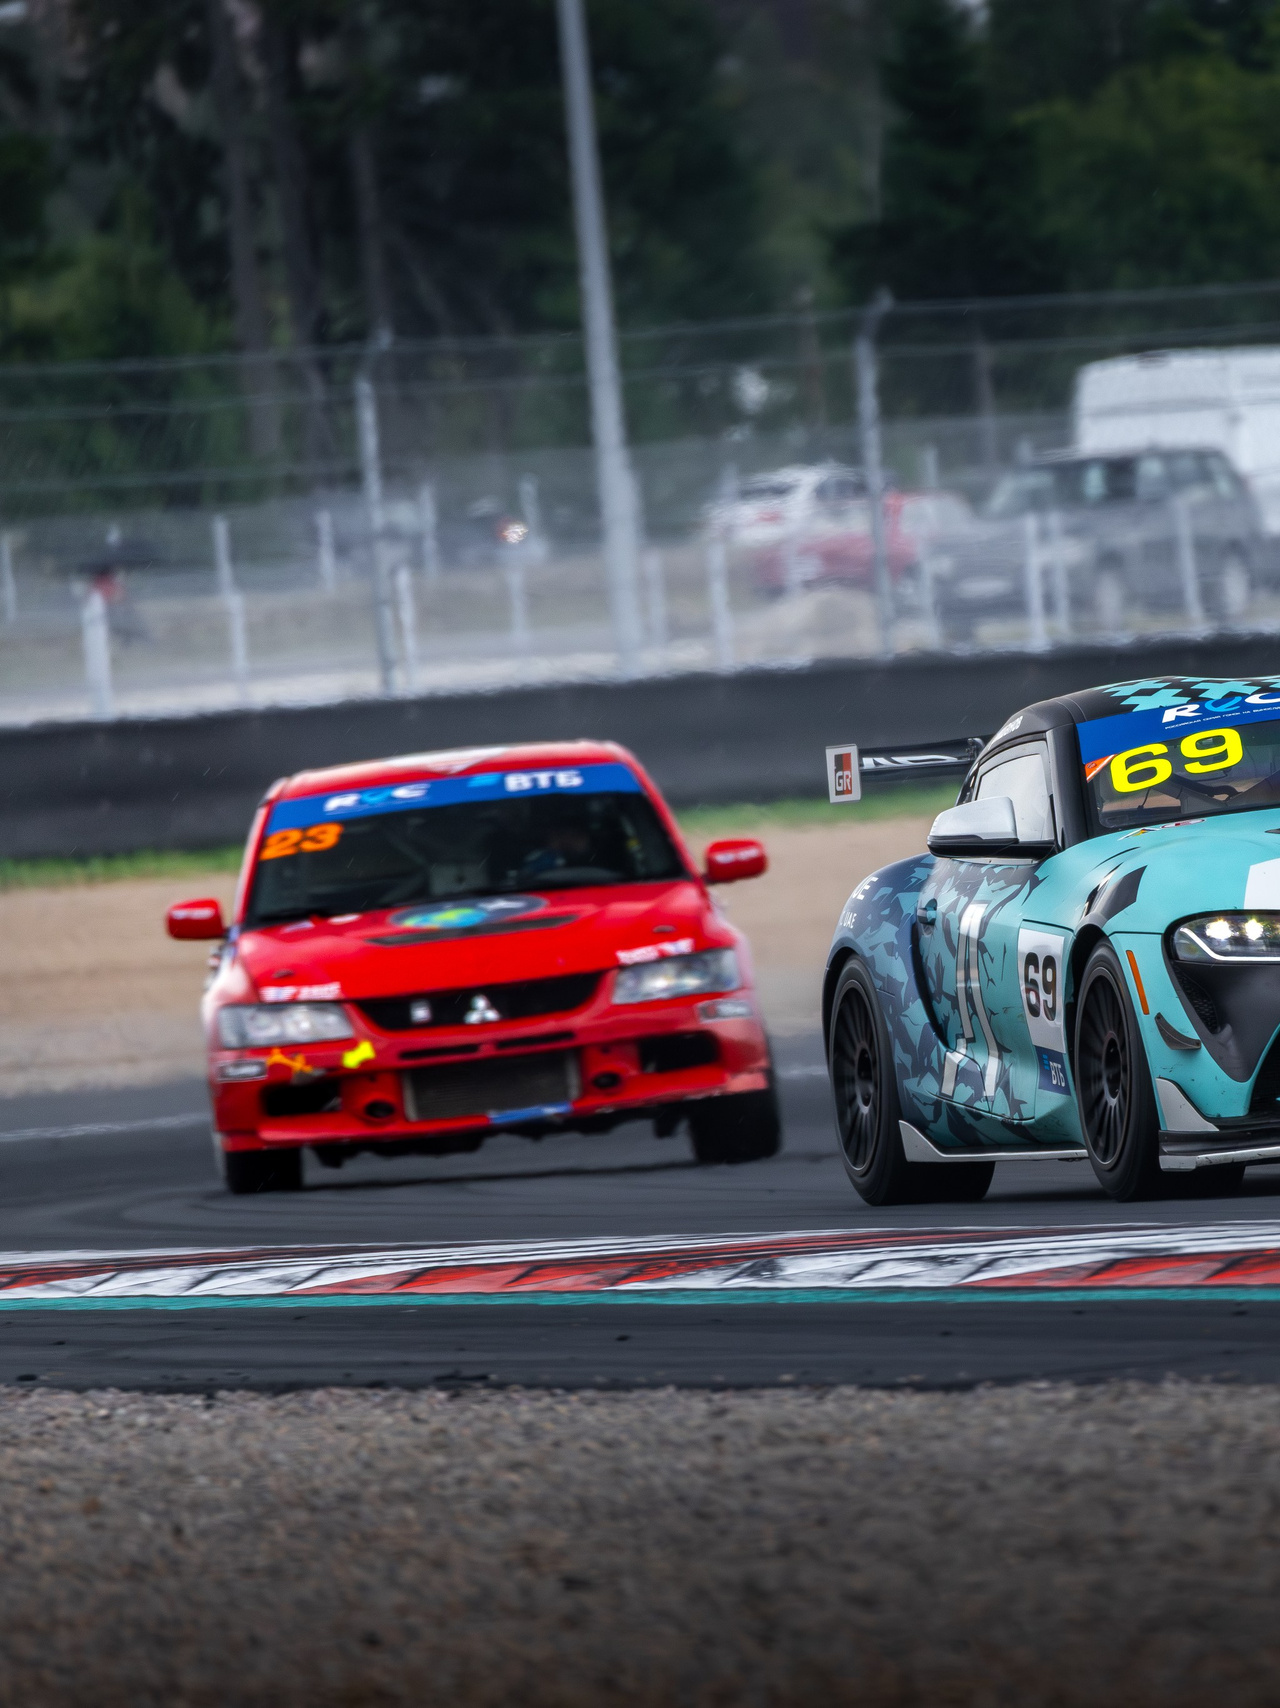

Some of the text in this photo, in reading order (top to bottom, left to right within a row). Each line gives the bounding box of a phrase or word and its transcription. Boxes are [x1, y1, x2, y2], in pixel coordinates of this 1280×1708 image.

[1110, 728, 1244, 793] 69
[503, 769, 584, 792] ВТБ
[835, 771, 852, 791] GR
[258, 822, 345, 861] 23
[1024, 952, 1057, 1022] 69
[1049, 1061, 1066, 1088] ВТБ
